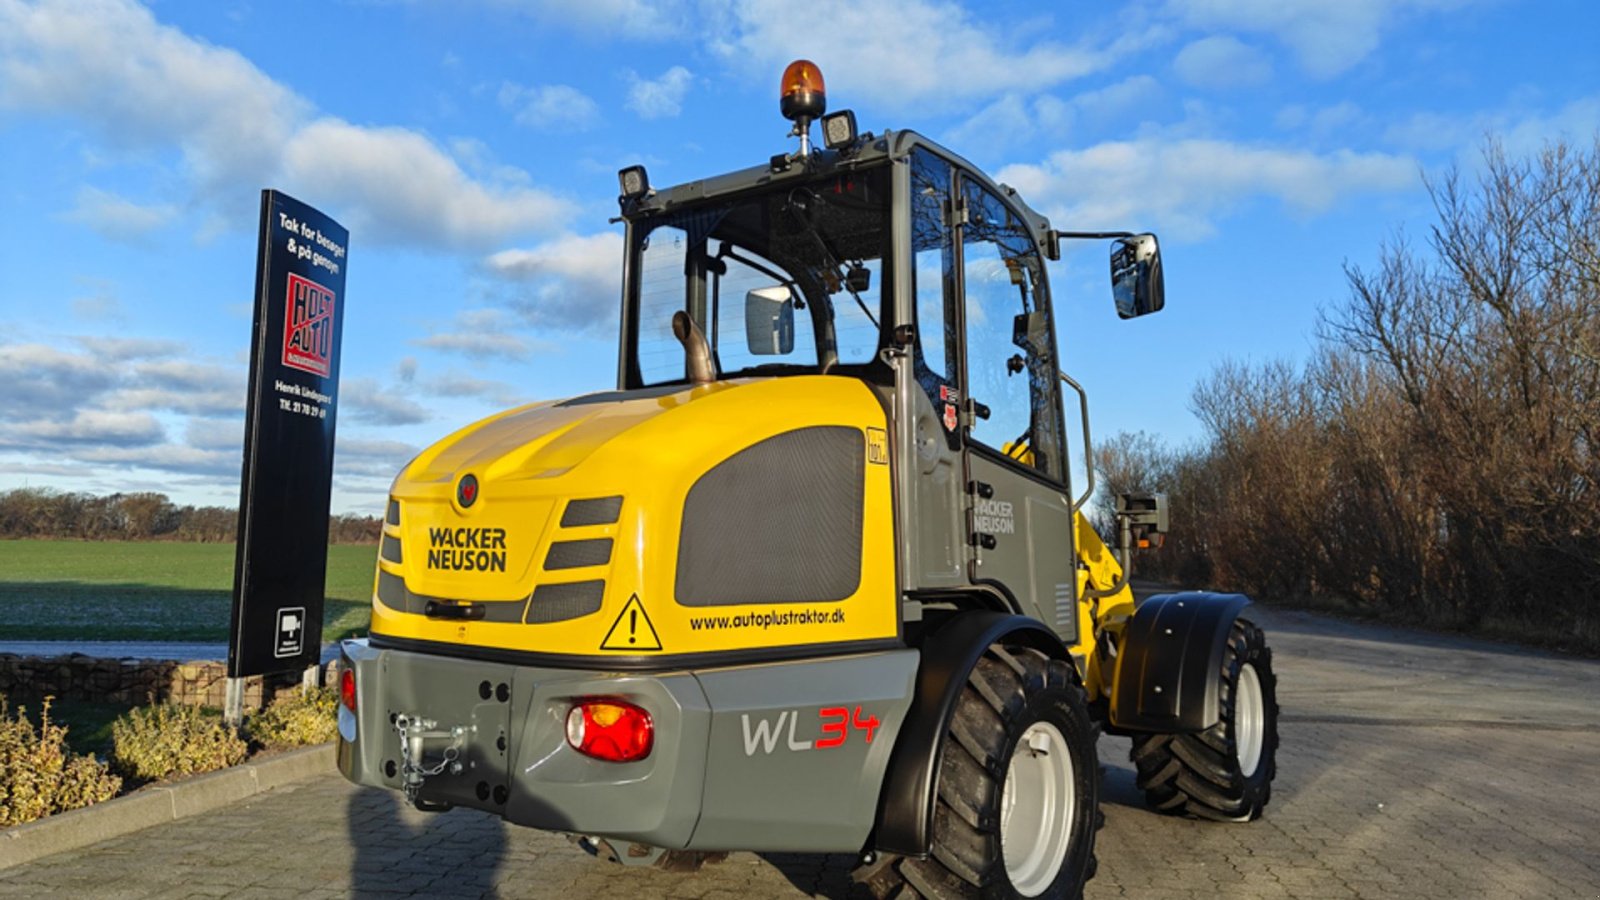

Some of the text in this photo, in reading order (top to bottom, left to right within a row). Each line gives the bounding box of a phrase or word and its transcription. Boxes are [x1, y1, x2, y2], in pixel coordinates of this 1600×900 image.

[279, 212, 300, 234] Tak
[300, 222, 315, 241] for
[287, 238, 297, 254] &
[298, 245, 312, 260] på
[289, 316, 330, 359] AUTO
[275, 379, 301, 396] Henrik
[974, 516, 1014, 534] NEUSON
[429, 527, 507, 549] WACKER
[428, 549, 506, 572] NEUSON
[690, 608, 846, 631] www.autoplustraktor.dk
